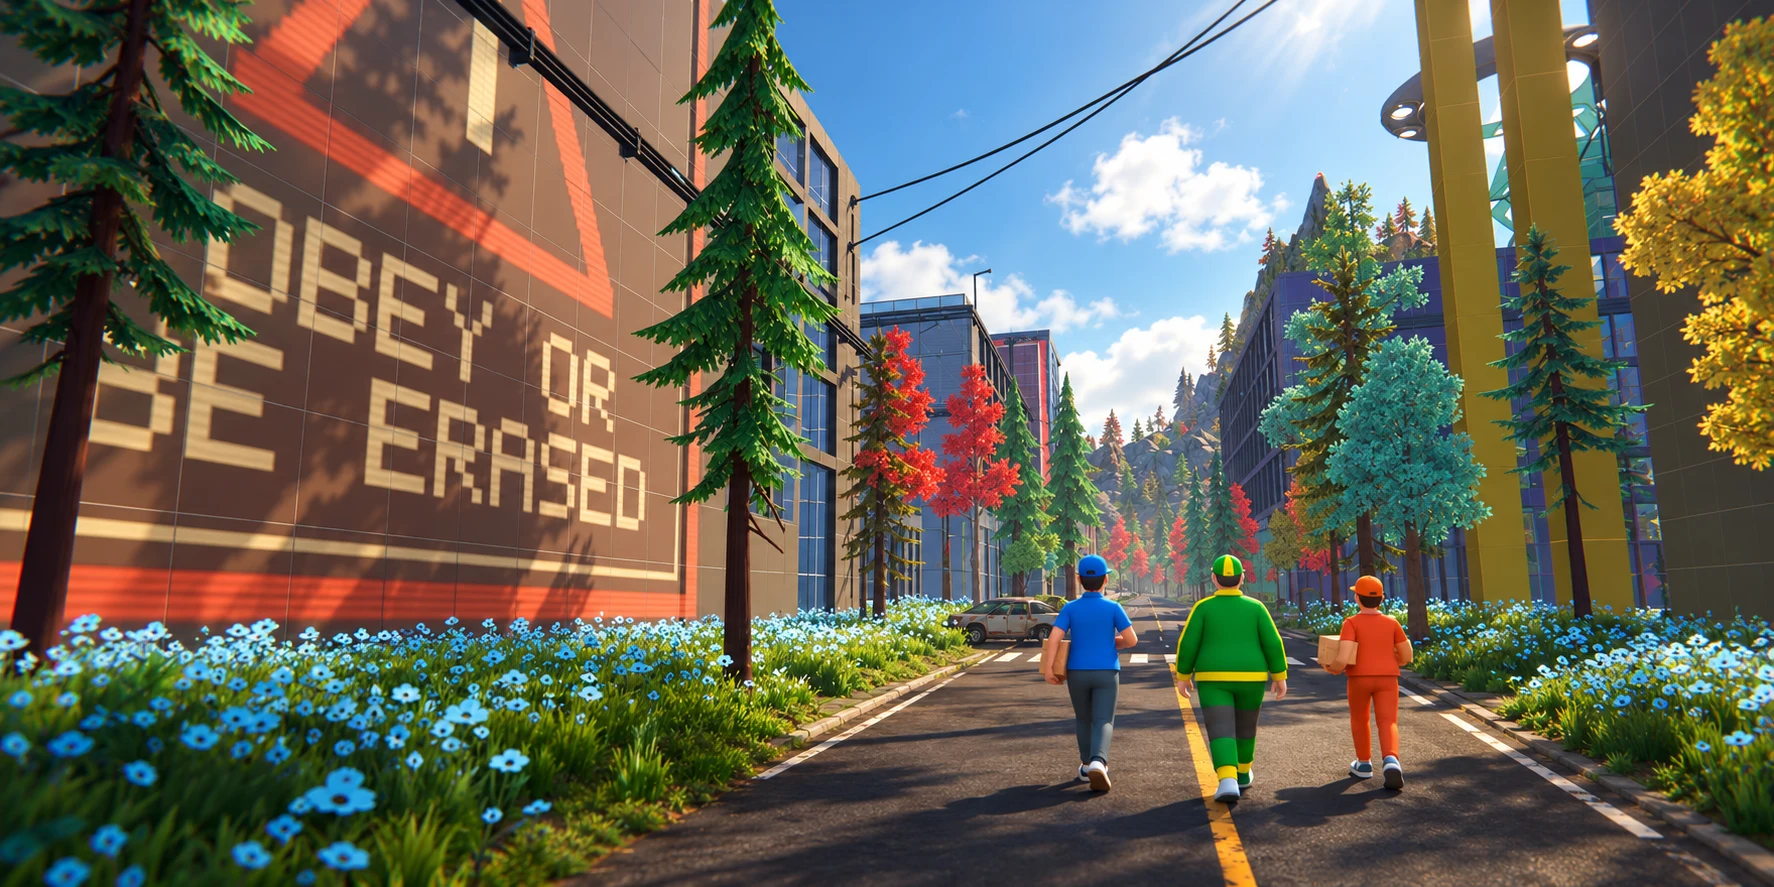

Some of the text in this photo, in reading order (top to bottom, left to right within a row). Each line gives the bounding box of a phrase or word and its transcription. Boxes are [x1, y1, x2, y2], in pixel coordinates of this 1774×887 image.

[203, 183, 615, 432] OBEY OR
[364, 377, 646, 531] ERASED
